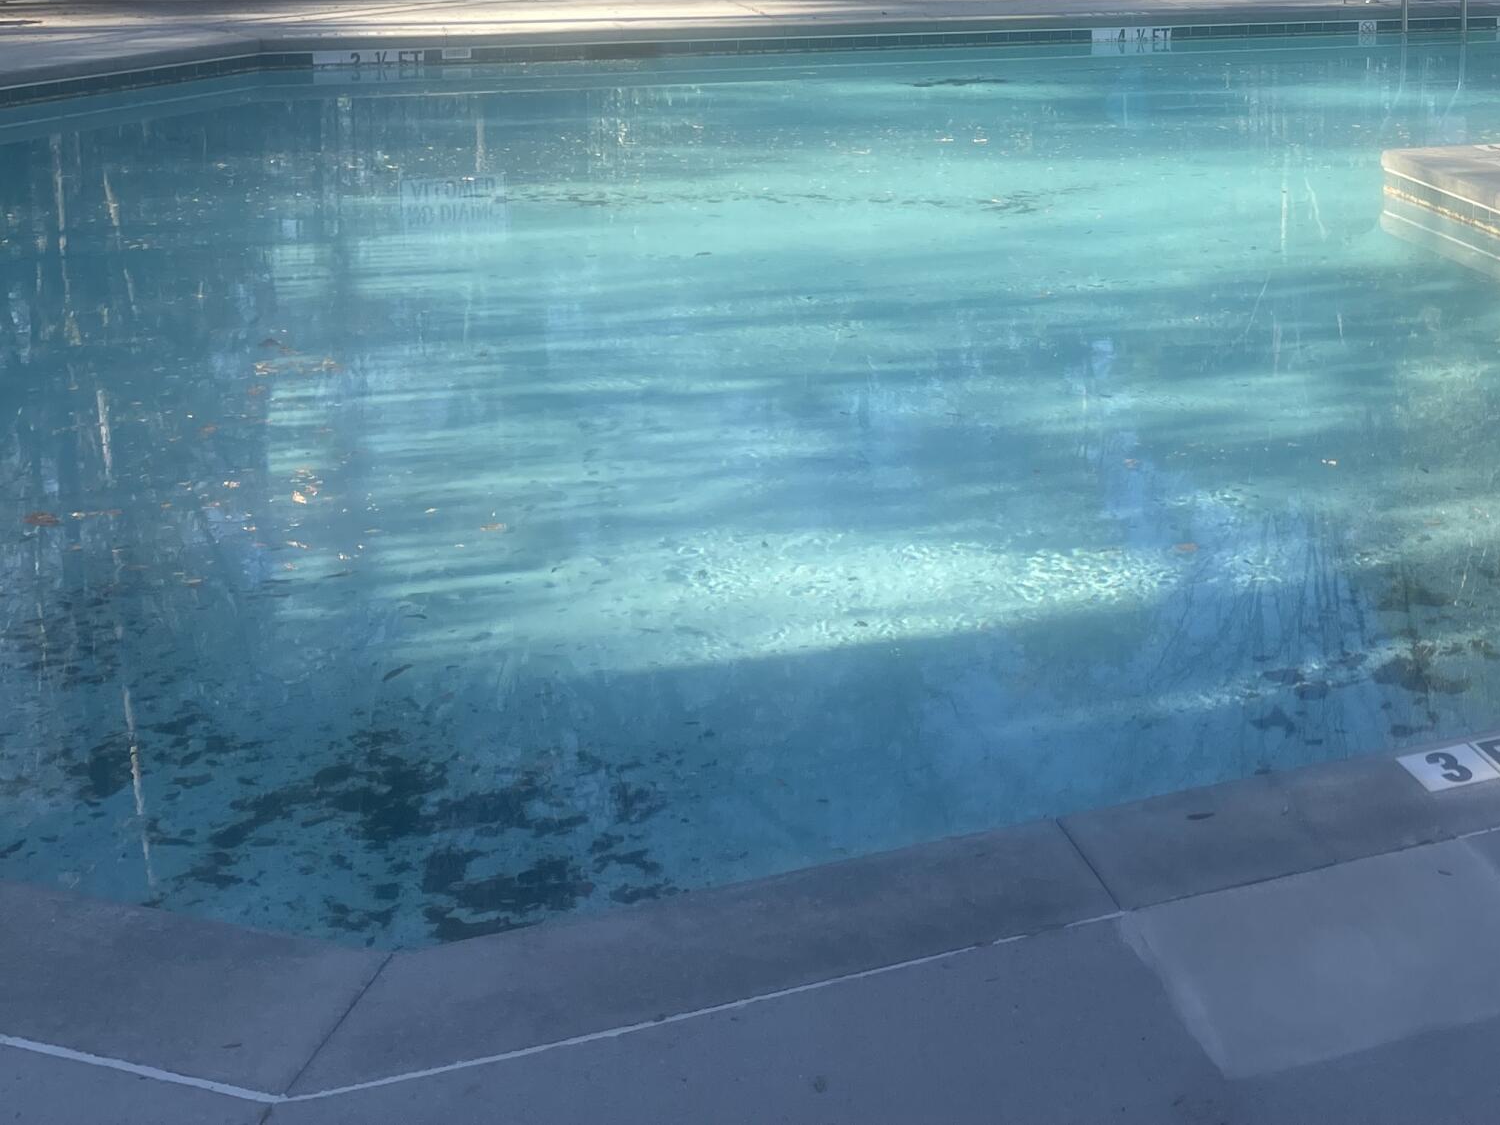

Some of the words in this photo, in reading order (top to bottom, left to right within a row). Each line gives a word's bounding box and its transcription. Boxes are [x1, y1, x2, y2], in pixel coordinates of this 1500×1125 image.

[1152, 28, 1170, 43] FT
[399, 50, 423, 65] FT
[1424, 751, 1473, 783] 3
